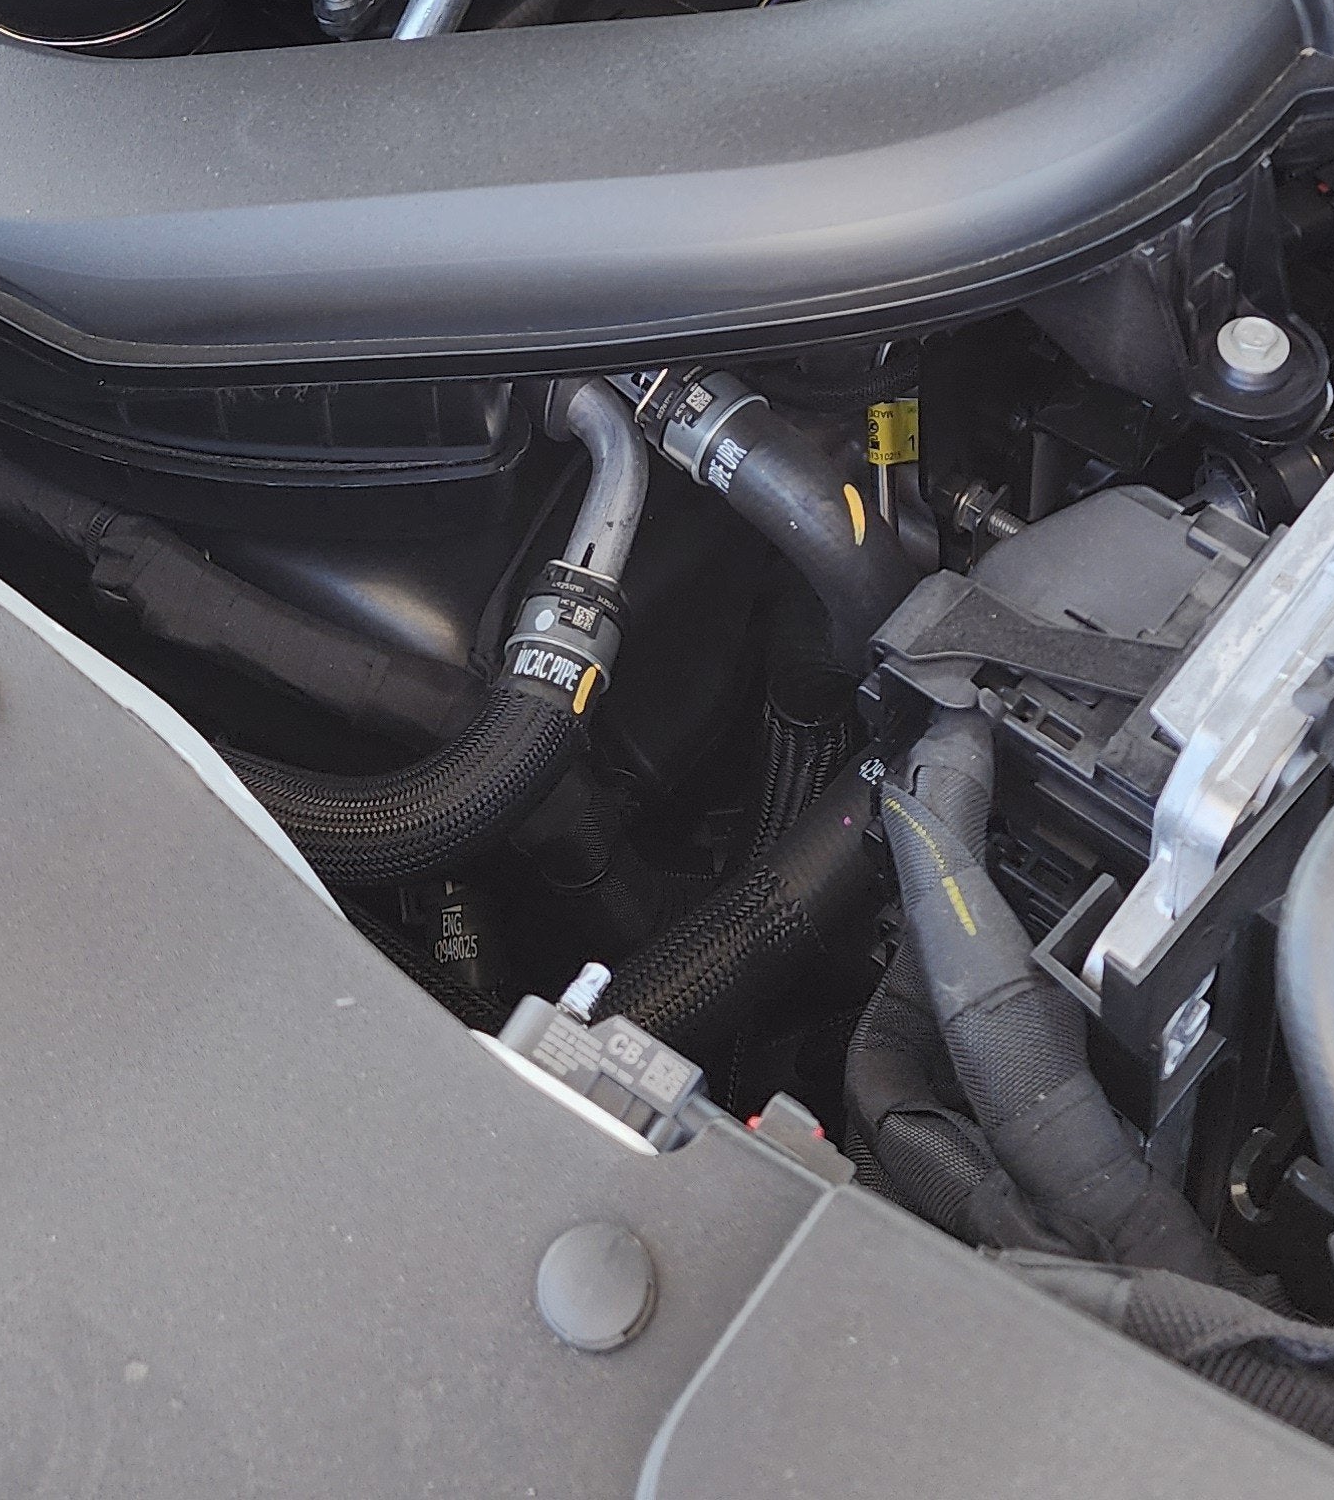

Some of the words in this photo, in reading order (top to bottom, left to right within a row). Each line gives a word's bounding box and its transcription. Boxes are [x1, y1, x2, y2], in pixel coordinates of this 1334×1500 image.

[715, 437, 748, 471] UPR
[547, 655, 582, 692] PIPE
[442, 912, 462, 937] ENG
